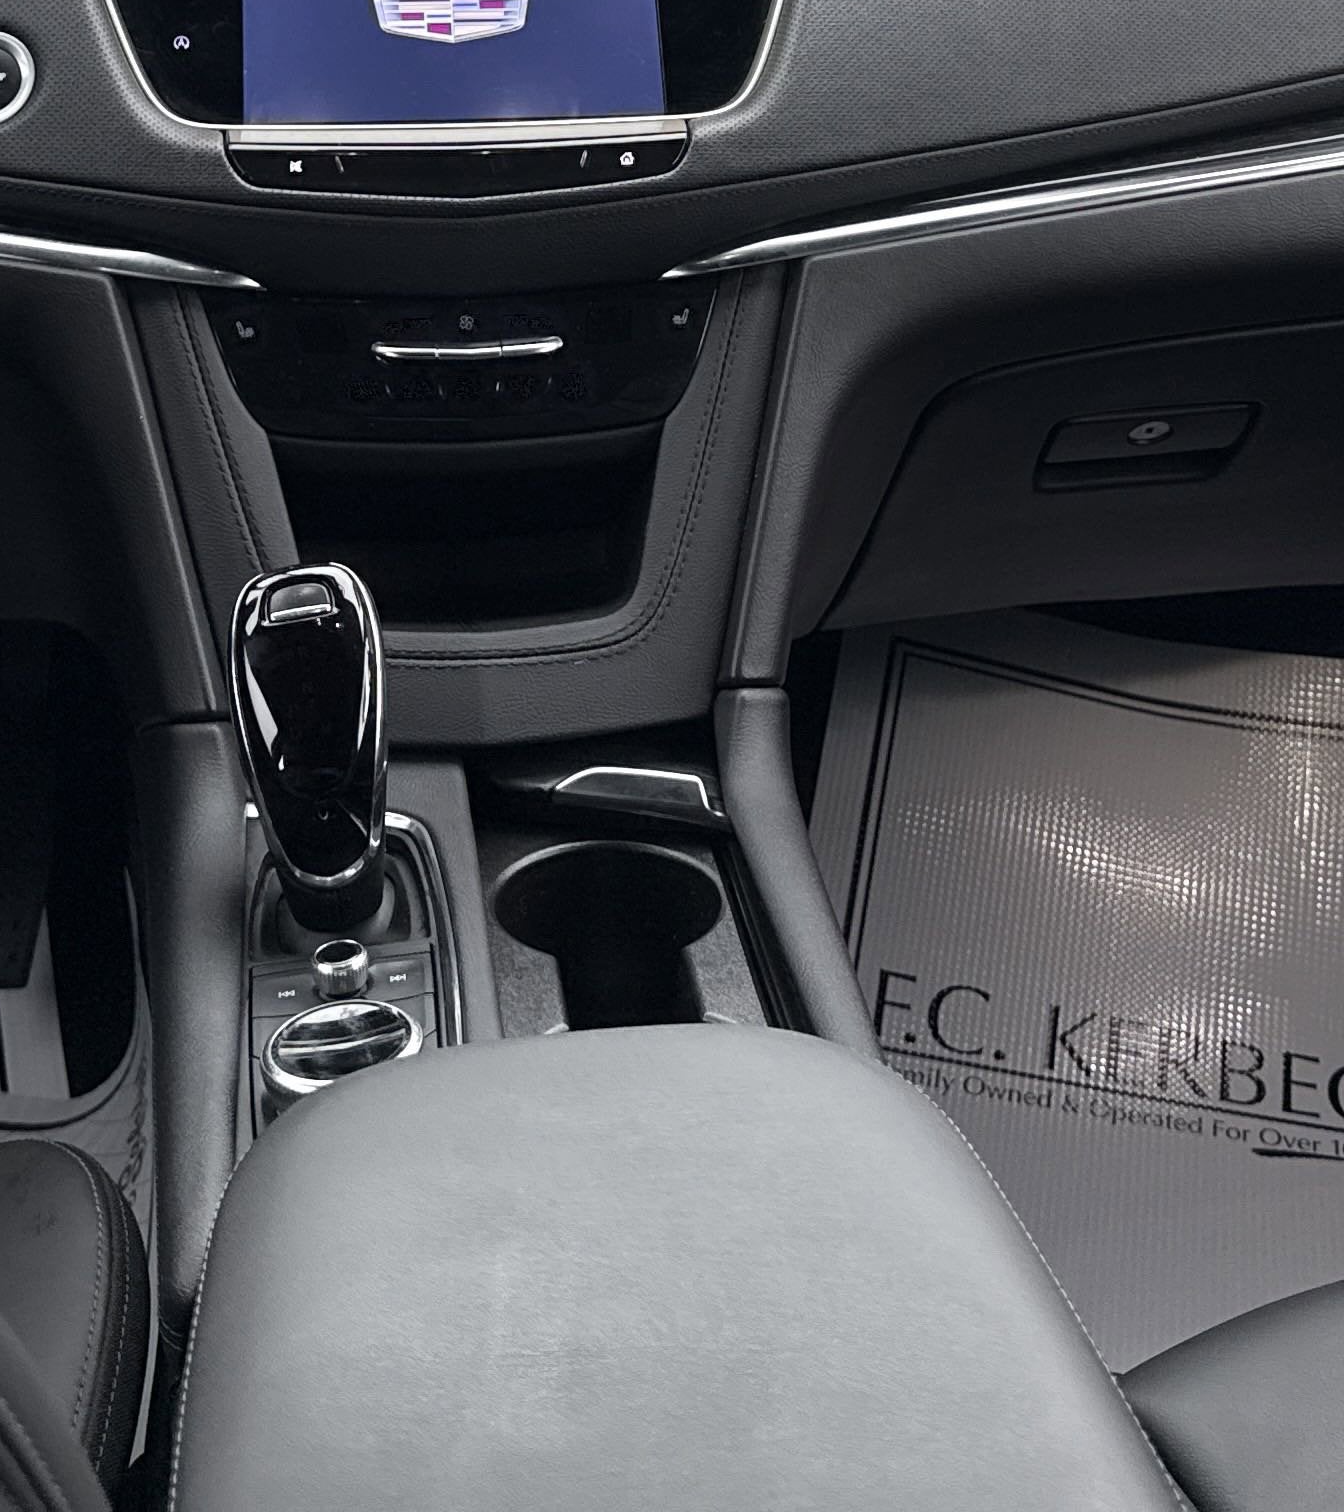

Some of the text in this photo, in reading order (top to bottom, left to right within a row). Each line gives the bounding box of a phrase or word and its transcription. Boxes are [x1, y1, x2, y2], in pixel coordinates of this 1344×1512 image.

[963, 1076, 1052, 1109] Owned
[1090, 1097, 1204, 1135] Operated
[1212, 1119, 1252, 1143] For
[1259, 1127, 1321, 1150] Over
